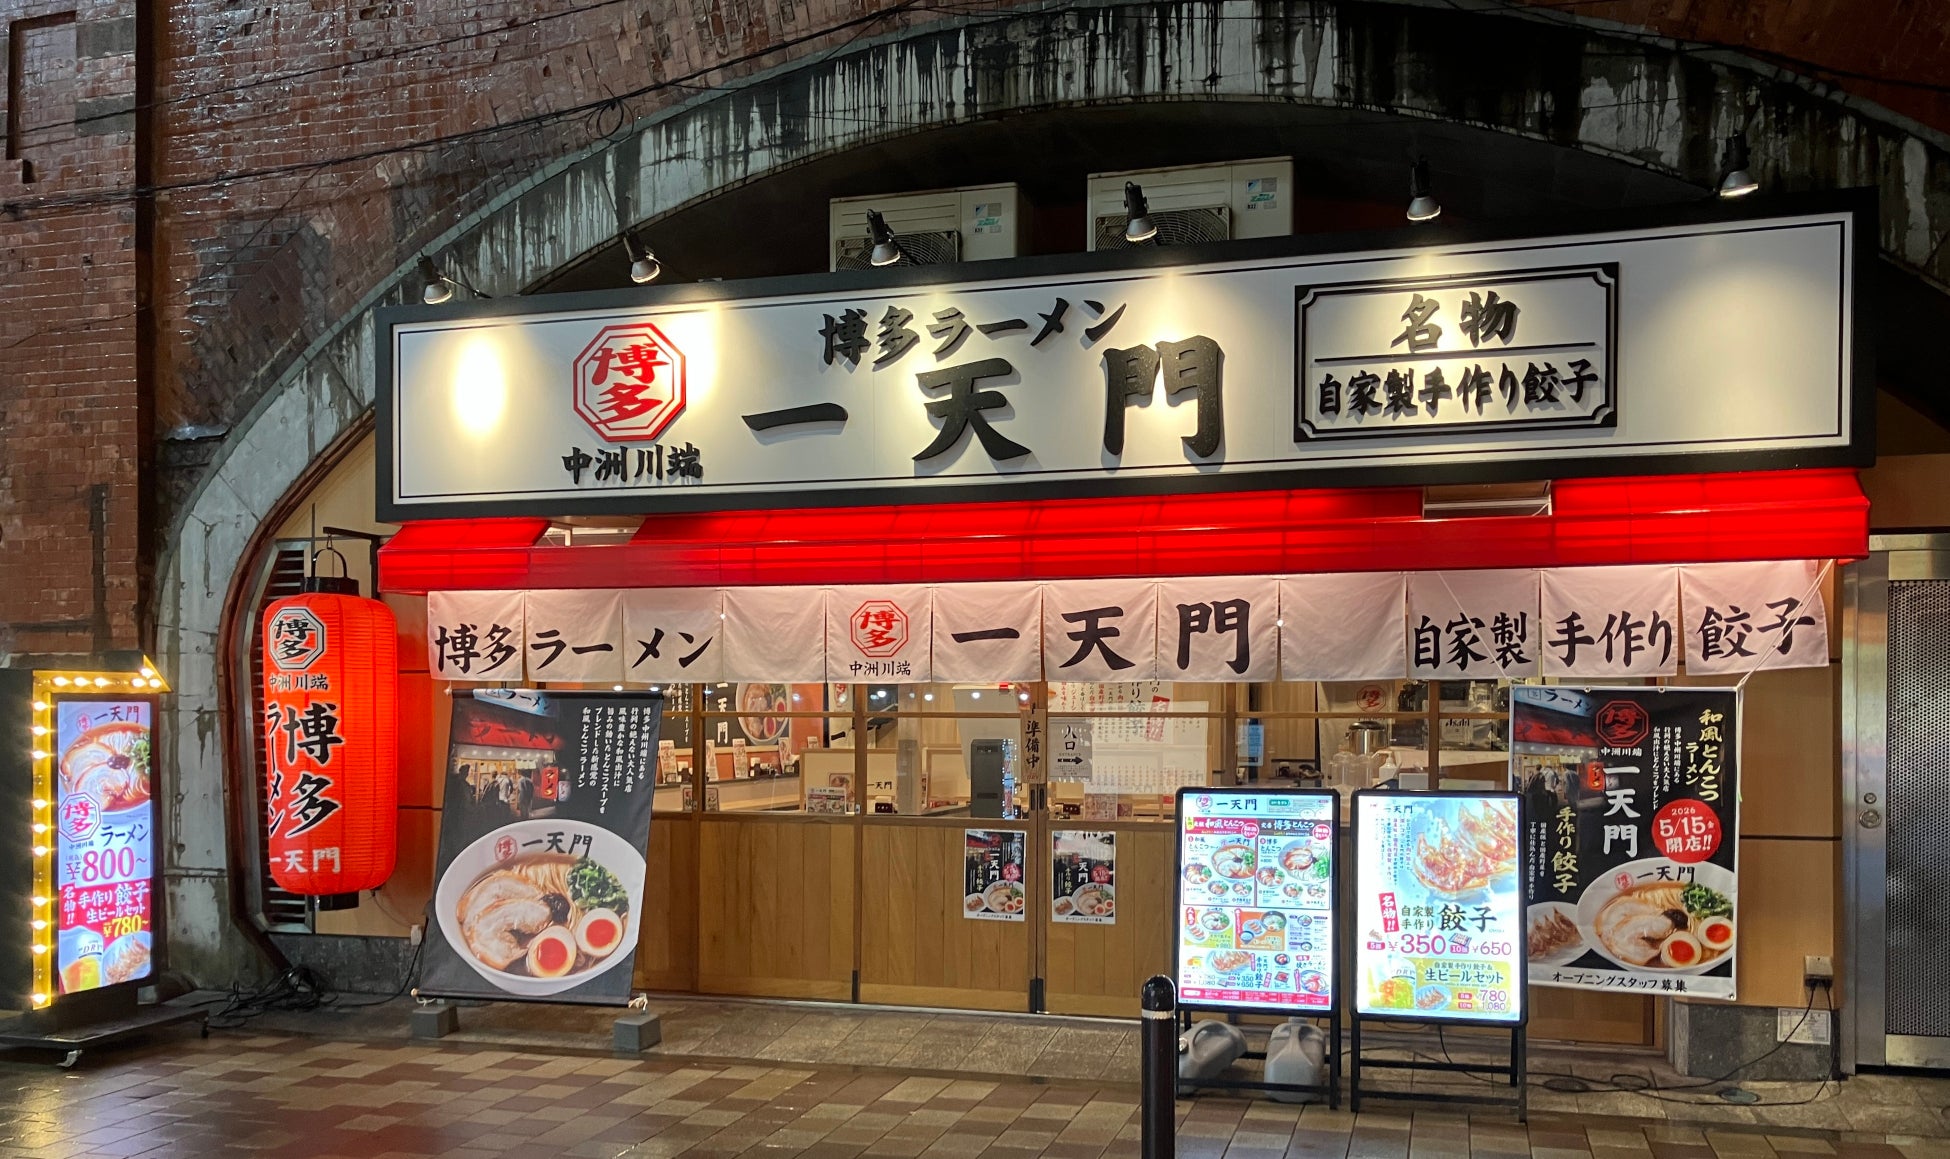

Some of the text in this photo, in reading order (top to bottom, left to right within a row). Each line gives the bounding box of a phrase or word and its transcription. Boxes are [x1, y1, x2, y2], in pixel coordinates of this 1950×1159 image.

[818, 298, 1127, 367] 博多ラーメン
[1393, 291, 1519, 350] 名物
[591, 342, 670, 425] 博多
[1316, 358, 1598, 421] 自家製手作り餃子
[742, 336, 1226, 475] 一天門
[562, 441, 704, 485] 中洲川端
[275, 618, 317, 662] 博多
[859, 609, 901, 649] 博多
[951, 598, 1252, 675] 一天門
[434, 622, 714, 675] 博多ラーメン
[269, 673, 330, 691] 中洲川端
[848, 660, 911, 677] 中洲川端
[94, 705, 140, 723] 一天門
[1025, 720, 1042, 768] 準備中
[1600, 747, 1642, 757] 中洲川端
[1699, 708, 1723, 801] 和風とんこつ
[282, 701, 344, 840] 博多
[1685, 741, 1699, 785] ラーメン
[64, 800, 96, 836] 博多
[1216, 798, 1257, 811] 一天門
[1384, 804, 1413, 814] 一天門
[1603, 765, 1642, 858] 一天門
[1671, 806, 1696, 816] 2026
[101, 823, 149, 848] ラーメン
[522, 831, 592, 858] 一天門
[1551, 806, 1579, 894] 手作り餃子
[1665, 833, 1712, 854] 開店!!
[269, 846, 342, 874] 一天門
[1637, 866, 1696, 884] 一天門
[63, 886, 76, 925] 名物!!
[78, 880, 149, 910] 手作り餃子
[1401, 905, 1434, 917] 自家製
[86, 903, 146, 924] 生ビールセット
[1381, 894, 1396, 932] 名物!!
[1401, 919, 1435, 930] 手作り
[1438, 903, 1497, 933] 餃子
[1425, 968, 1504, 984] 生ビールセット
[1552, 972, 1688, 993] オープニングスタッフ募集
